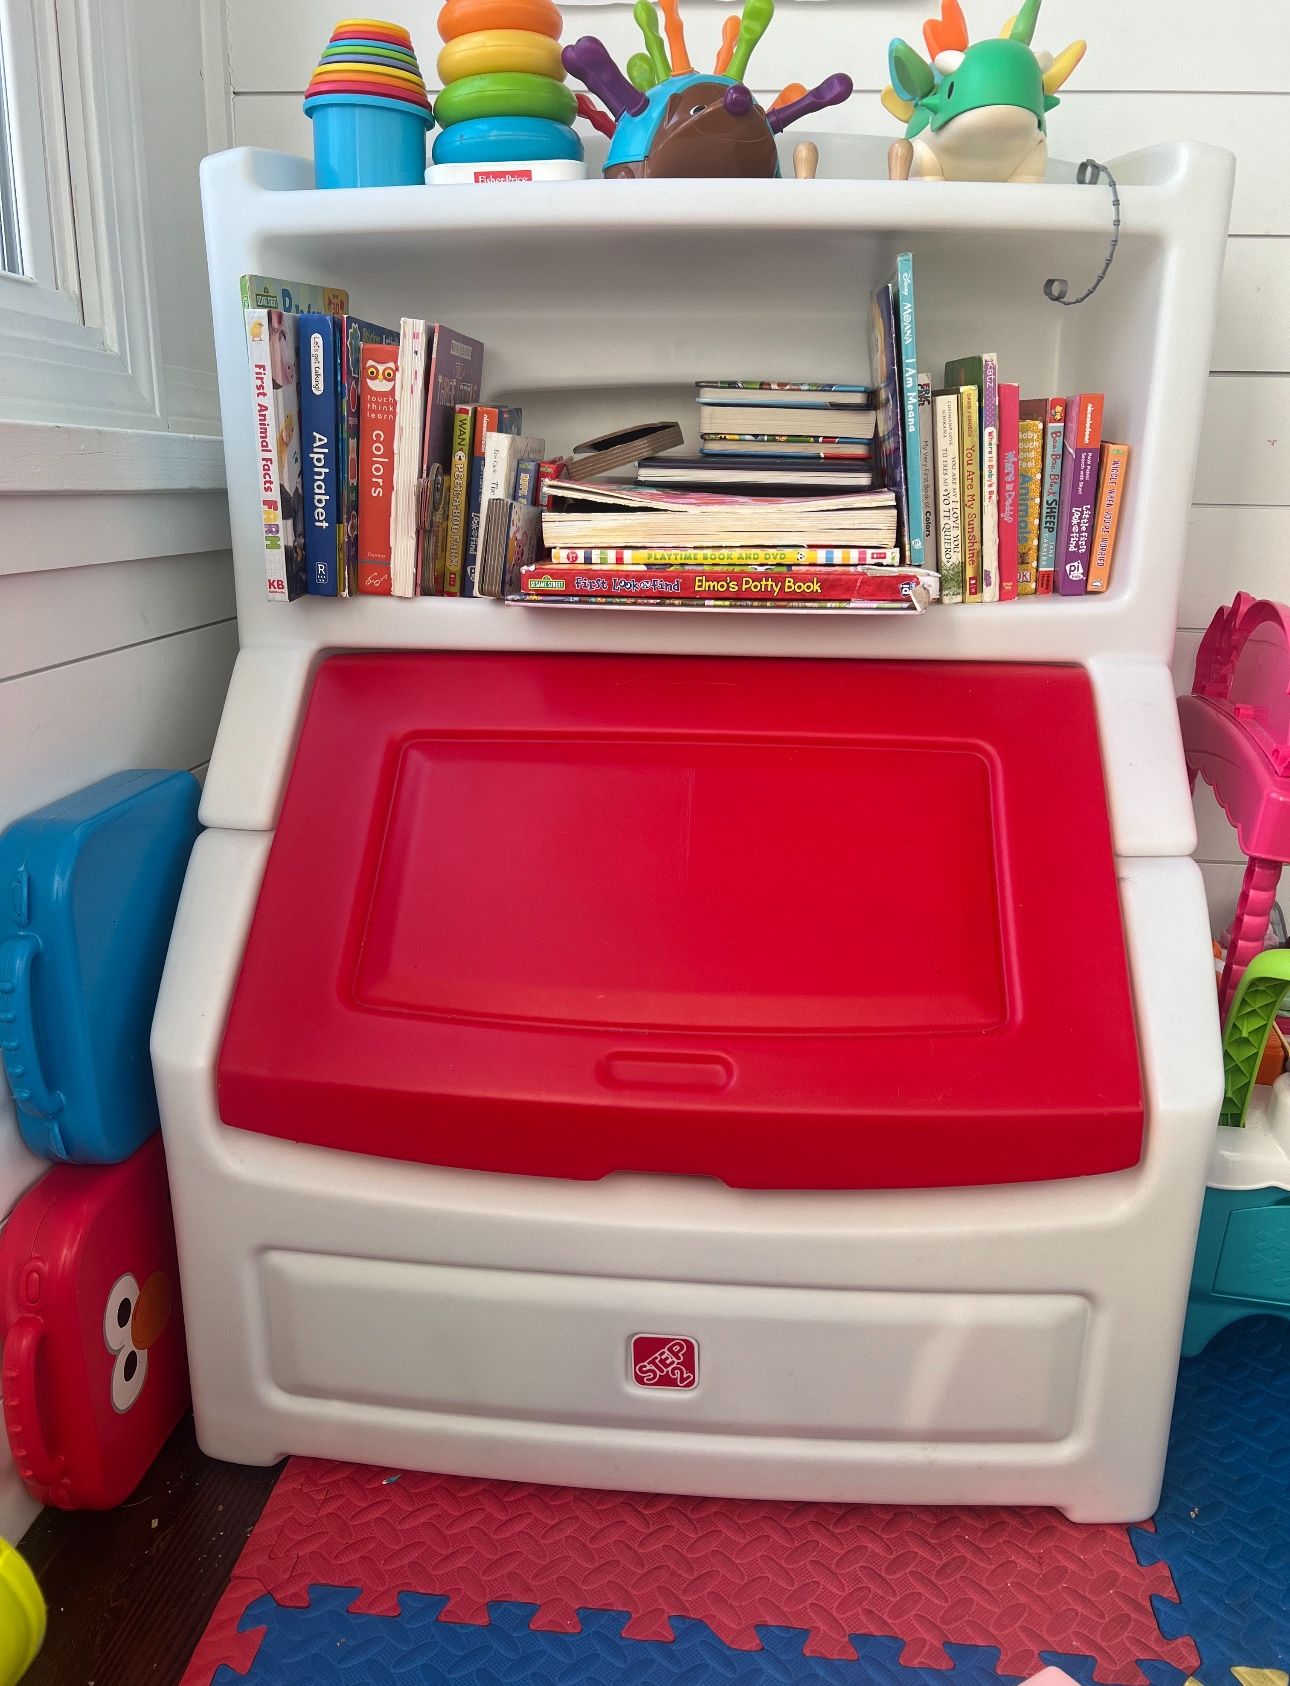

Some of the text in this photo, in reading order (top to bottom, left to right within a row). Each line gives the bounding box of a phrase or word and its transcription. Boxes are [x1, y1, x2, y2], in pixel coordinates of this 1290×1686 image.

[902, 302, 912, 345] MOANA
[311, 353, 321, 364] get
[905, 367, 916, 388] Am
[986, 359, 996, 387] katz
[367, 404, 394, 412] think
[367, 412, 394, 420] learn
[907, 392, 918, 433] Moana
[457, 418, 468, 447] WAN
[254, 364, 281, 550] First Animal Facts FARM
[371, 430, 389, 497] colors
[921, 452, 930, 468] Very
[965, 445, 975, 467] You
[309, 431, 330, 529] Alphabet
[966, 469, 976, 490] Are
[1108, 460, 1120, 486] WIGGLE
[965, 494, 976, 510] My
[943, 508, 952, 521] TE
[952, 507, 960, 531] LOVE
[1044, 499, 1057, 534] SHEEP
[1071, 507, 1082, 526] Look
[1080, 504, 1091, 532] Little
[952, 534, 961, 554] YOU
[967, 513, 978, 567] Sunshine
[647, 552, 787, 561] PLAYTIME BOOK AND DVD
[267, 578, 285, 590] KB
[530, 580, 564, 589] SESAME STREET
[612, 577, 639, 591] Look
[694, 576, 822, 596] Elmo's Potty Book
[635, 1339, 687, 1384] STEP
